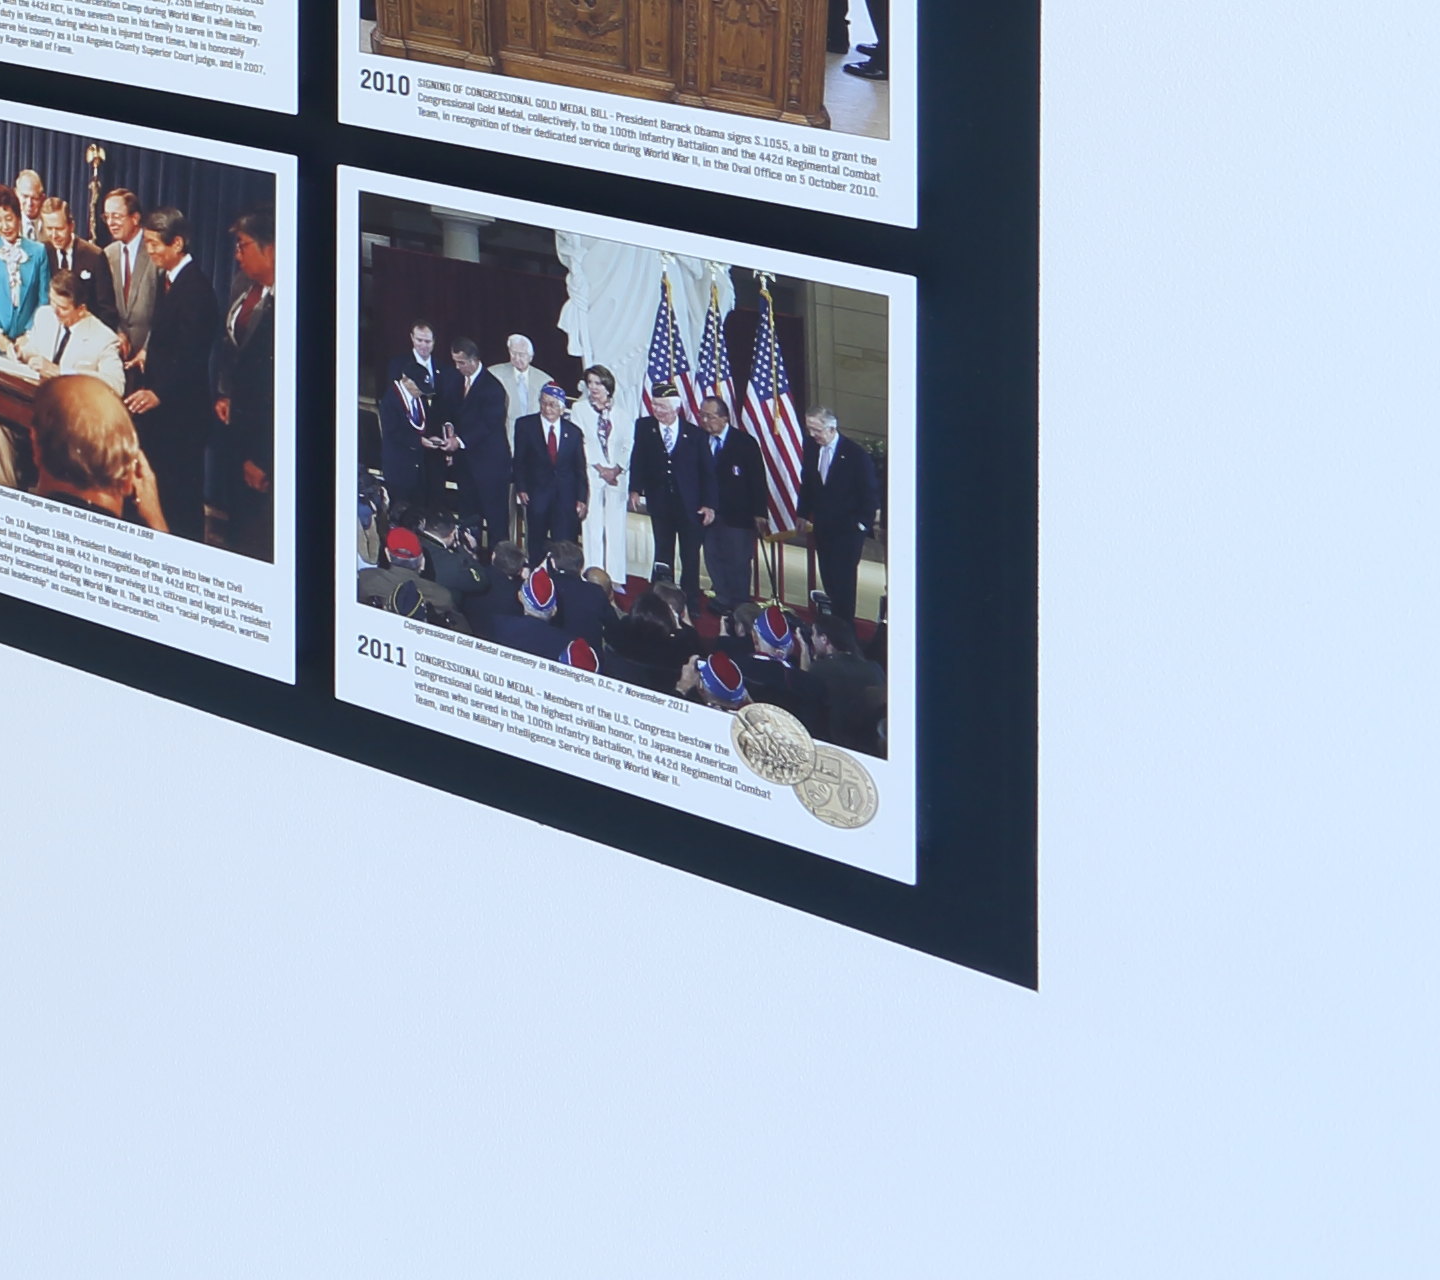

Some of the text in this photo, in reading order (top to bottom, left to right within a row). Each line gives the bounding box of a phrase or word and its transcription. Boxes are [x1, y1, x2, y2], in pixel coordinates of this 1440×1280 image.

[361, 69, 409, 95] 2010
[416, 77, 451, 93] SIGNING
[451, 83, 463, 95] OF
[464, 85, 532, 107] CONGRESSIONAL
[534, 97, 557, 111] GOLD
[558, 101, 587, 116] MEDAL
[589, 106, 607, 120] BILL
[614, 110, 658, 128] President
[659, 118, 692, 134] Barack
[692, 123, 725, 140] Obama
[726, 129, 752, 145] signs
[792, 142, 800, 152] a
[800, 141, 817, 155] bill
[818, 144, 830, 157] to
[830, 148, 858, 162] grant
[859, 151, 877, 165] the
[416, 92, 475, 112] Congressional
[476, 102, 496, 115] Gold
[496, 106, 524, 122] Medal,
[579, 120, 591, 132] to
[591, 122, 607, 135] the
[609, 125, 637, 140] 100th
[637, 130, 675, 149] Infantry
[676, 137, 719, 155] Battalion
[720, 146, 739, 158] and
[739, 148, 757, 161] the
[758, 151, 784, 166] 442d
[785, 155, 841, 176] Regimental
[841, 165, 881, 183] Combat
[417, 107, 879, 198] Team, in recognition of their dedicated service during World War II, in the Oval Office on 5 October 2010.
[358, 635, 406, 667] 2011
[413, 651, 730, 757] CONGRESSIONAL GOLD MEDAL Members of the U.S. Congress bestow the
